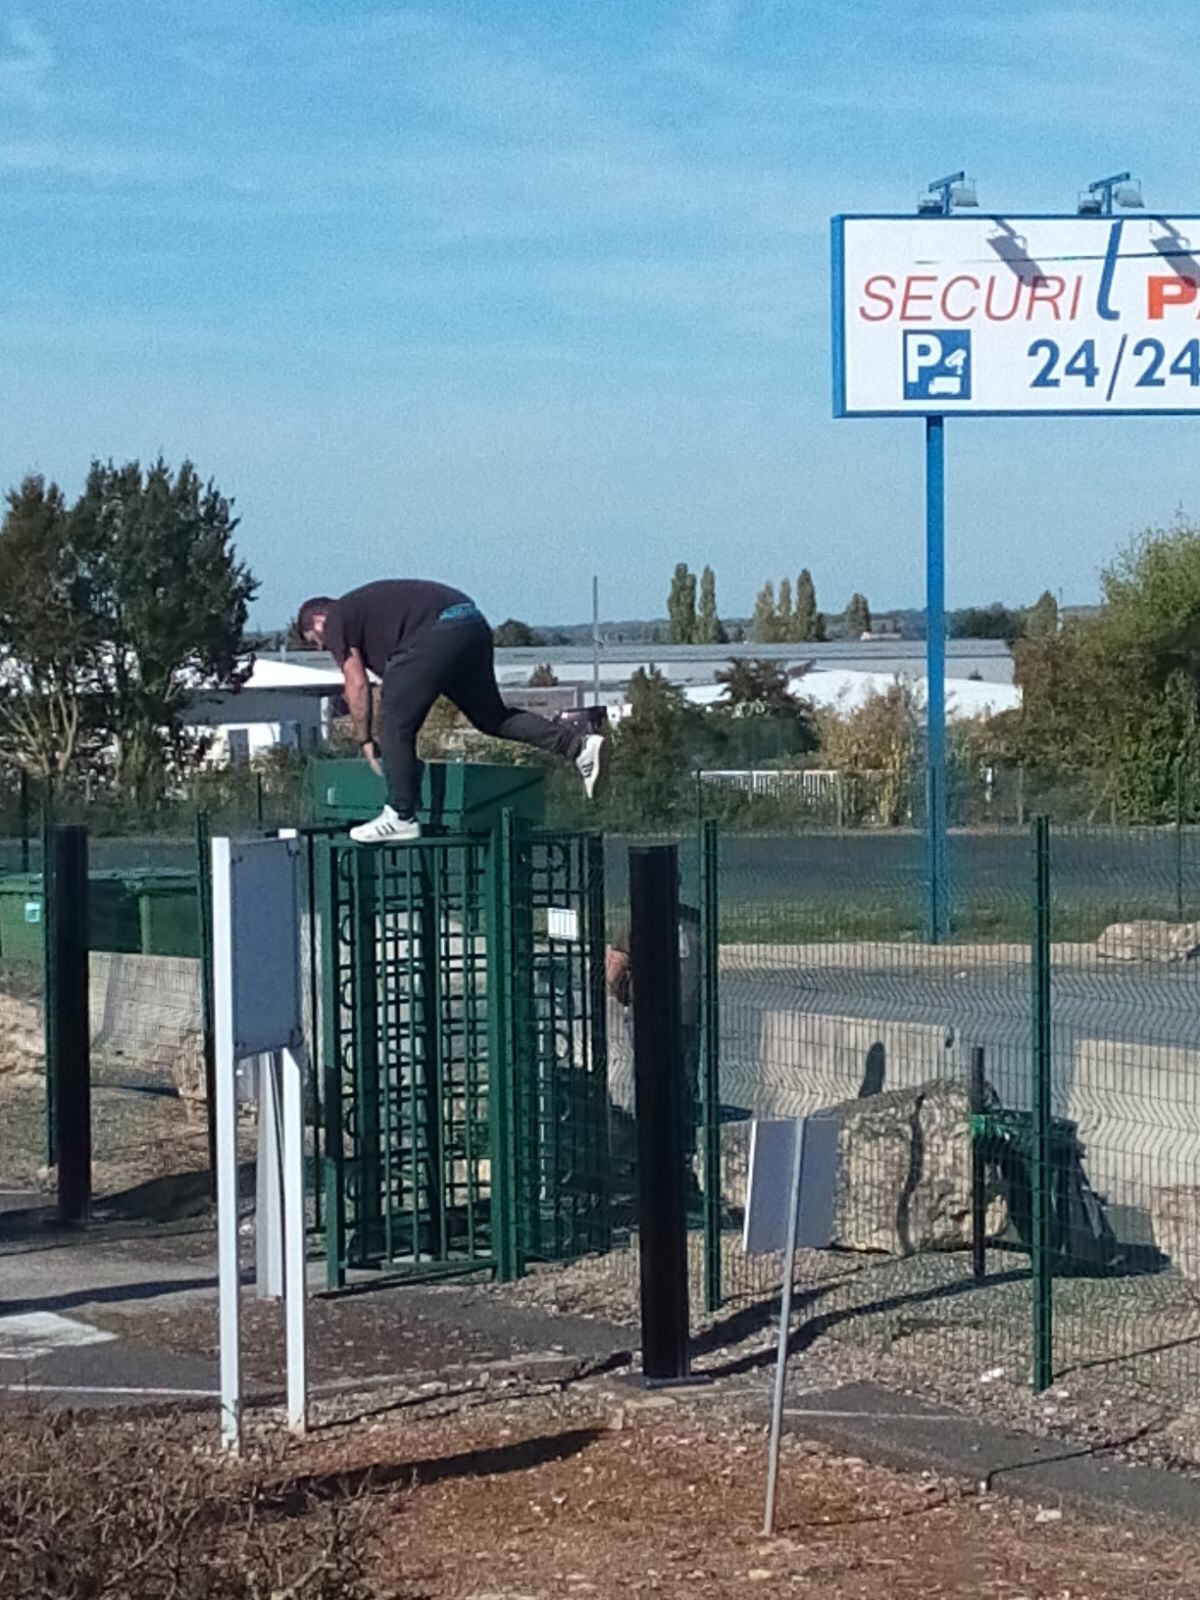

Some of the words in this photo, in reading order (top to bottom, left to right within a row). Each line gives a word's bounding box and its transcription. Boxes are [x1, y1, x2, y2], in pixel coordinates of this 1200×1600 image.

[1147, 275, 1200, 320] P
[906, 334, 943, 383] P
[1027, 334, 1200, 401] 24/24
